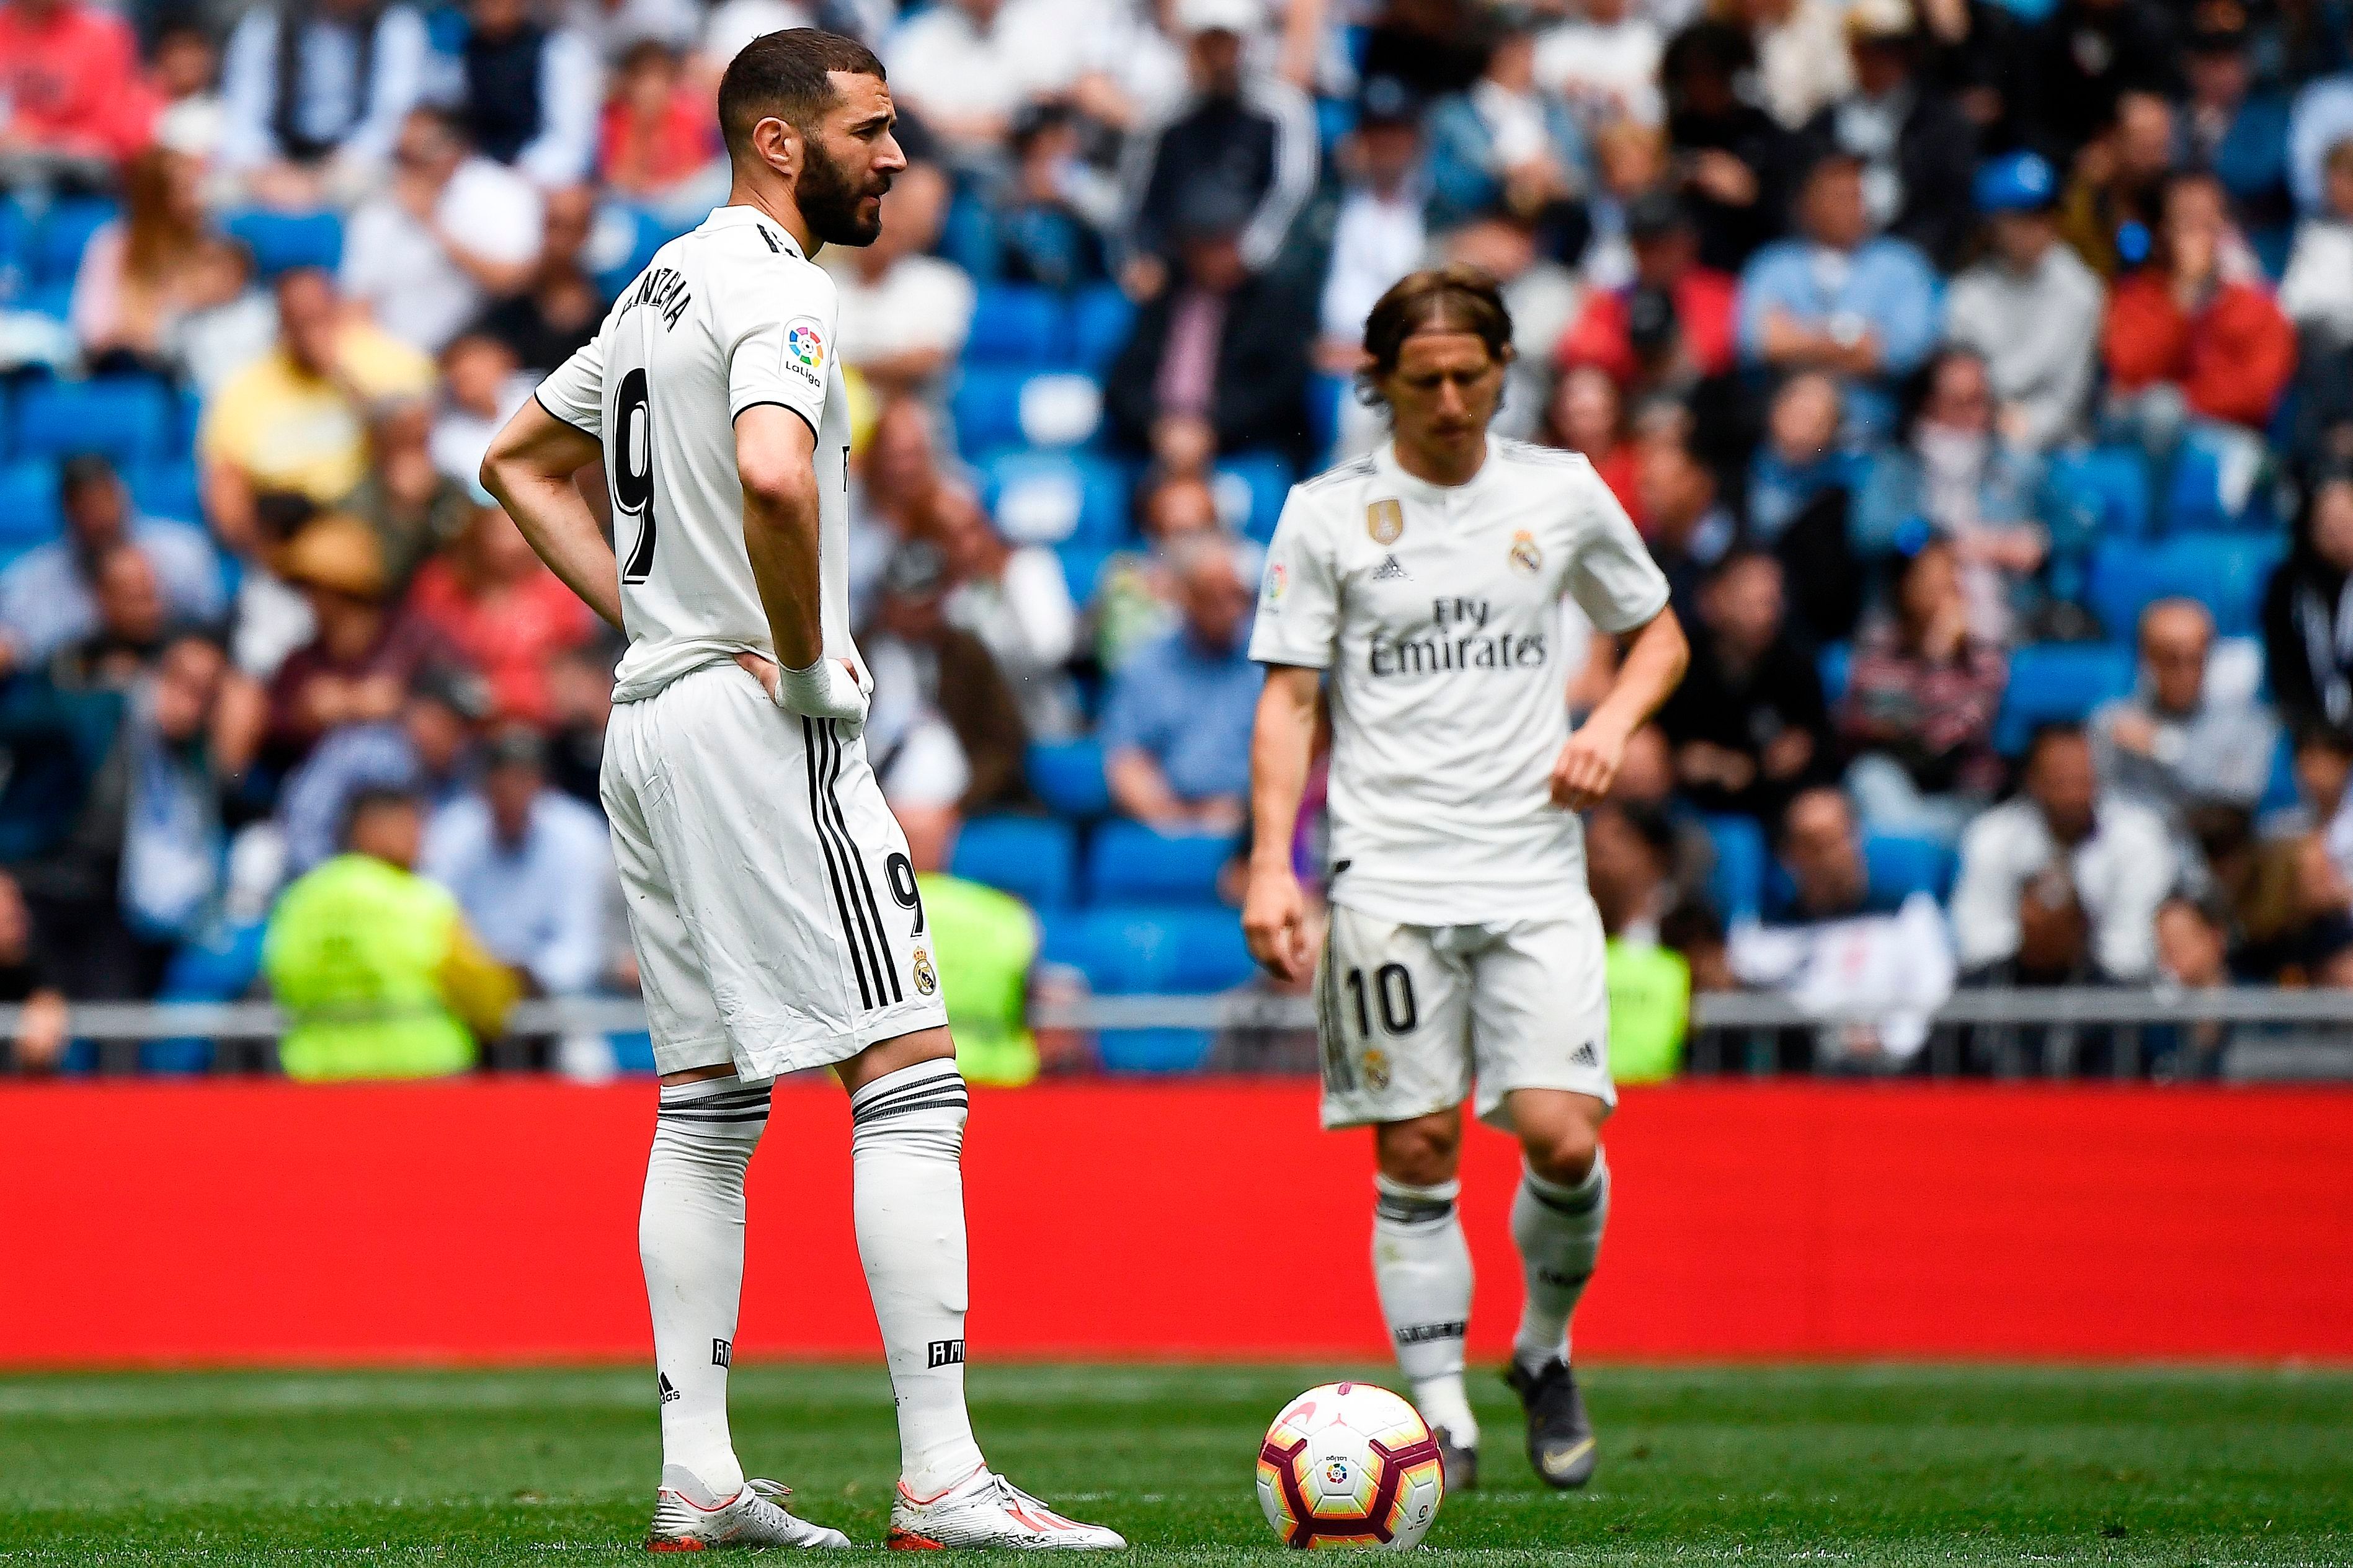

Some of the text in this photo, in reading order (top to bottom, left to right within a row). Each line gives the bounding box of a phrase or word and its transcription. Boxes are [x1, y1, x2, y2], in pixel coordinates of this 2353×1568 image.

[785, 360, 821, 388] LaLiga
[613, 368, 657, 585] 9
[1432, 596, 1488, 630] Fly
[1368, 632, 1547, 678] Emirates
[885, 852, 923, 937] 9
[1346, 962, 1417, 1038] 10
